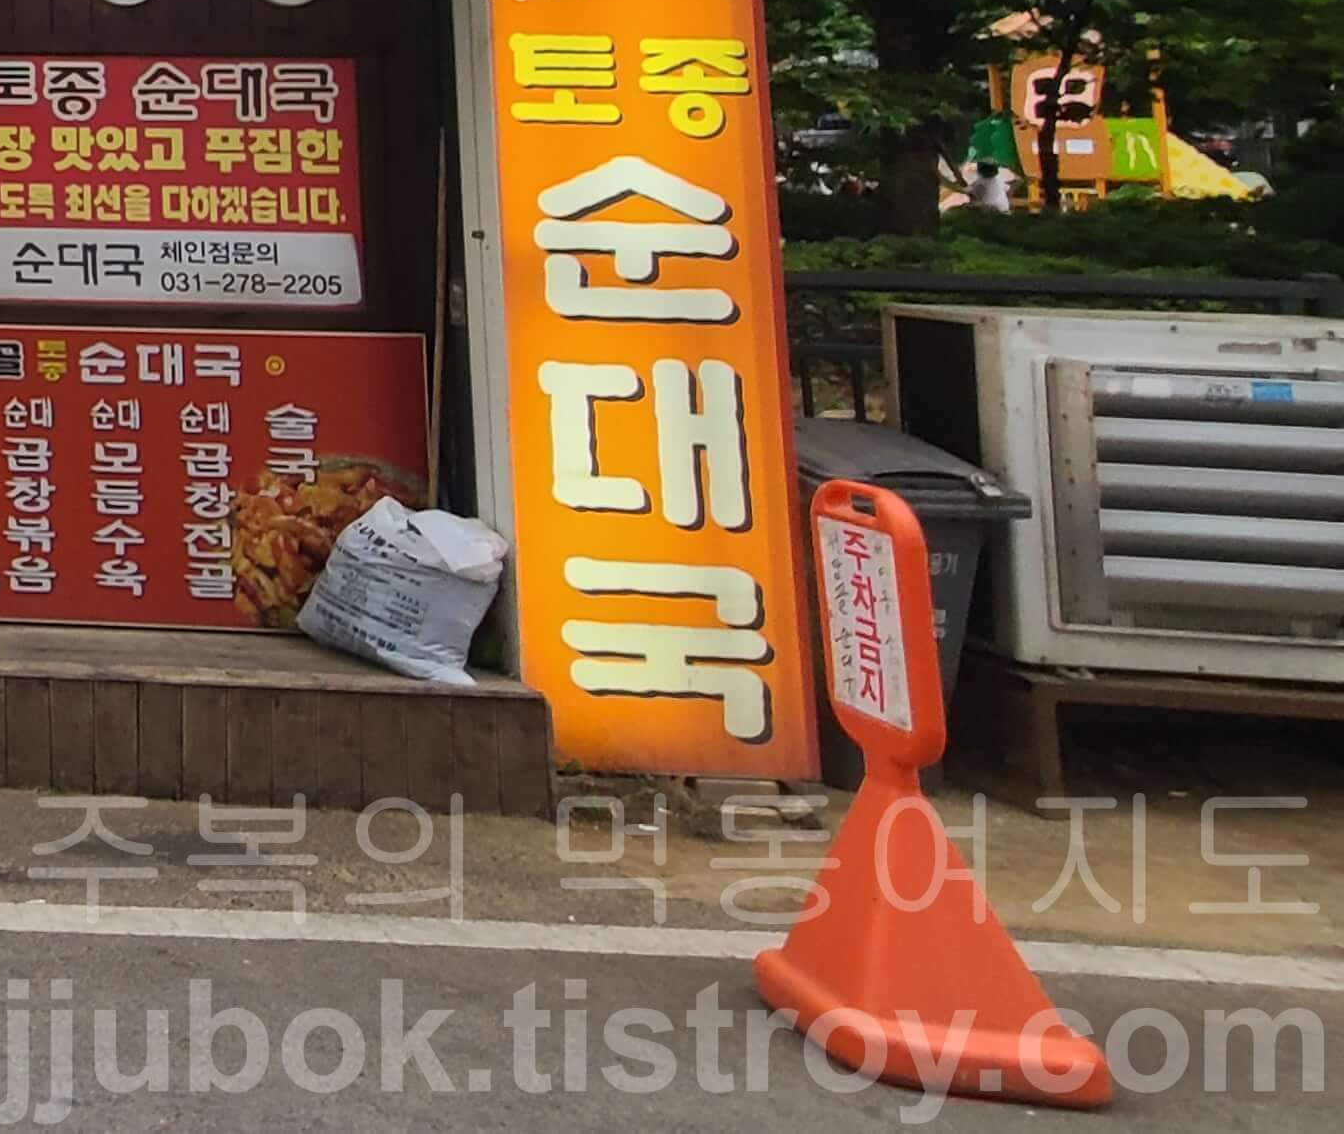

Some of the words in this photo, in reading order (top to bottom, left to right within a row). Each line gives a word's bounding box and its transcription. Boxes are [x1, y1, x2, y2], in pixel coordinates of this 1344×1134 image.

[133, 62, 339, 124] 순대국
[508, 32, 752, 139] 토종
[51, 127, 185, 172] 맛있고
[204, 129, 343, 174] 푸짐한
[65, 184, 151, 223] 최선을
[162, 185, 348, 225] 다하겠습니다.
[13, 241, 144, 287] 순대국
[161, 239, 279, 266] 체인점문의
[161, 271, 343, 296] 031-278-2205
[78, 340, 243, 387] 순대국
[3, 396, 54, 430] 순대
[90, 397, 141, 433] 순대
[179, 401, 231, 435] 순대
[263, 403, 321, 483] 술국
[533, 155, 775, 746] 순대국
[1, 436, 57, 594] 곱창볶음
[88, 440, 147, 597] 모듬수육
[179, 440, 235, 601] 곱창전골
[843, 529, 886, 713] 주차금지
